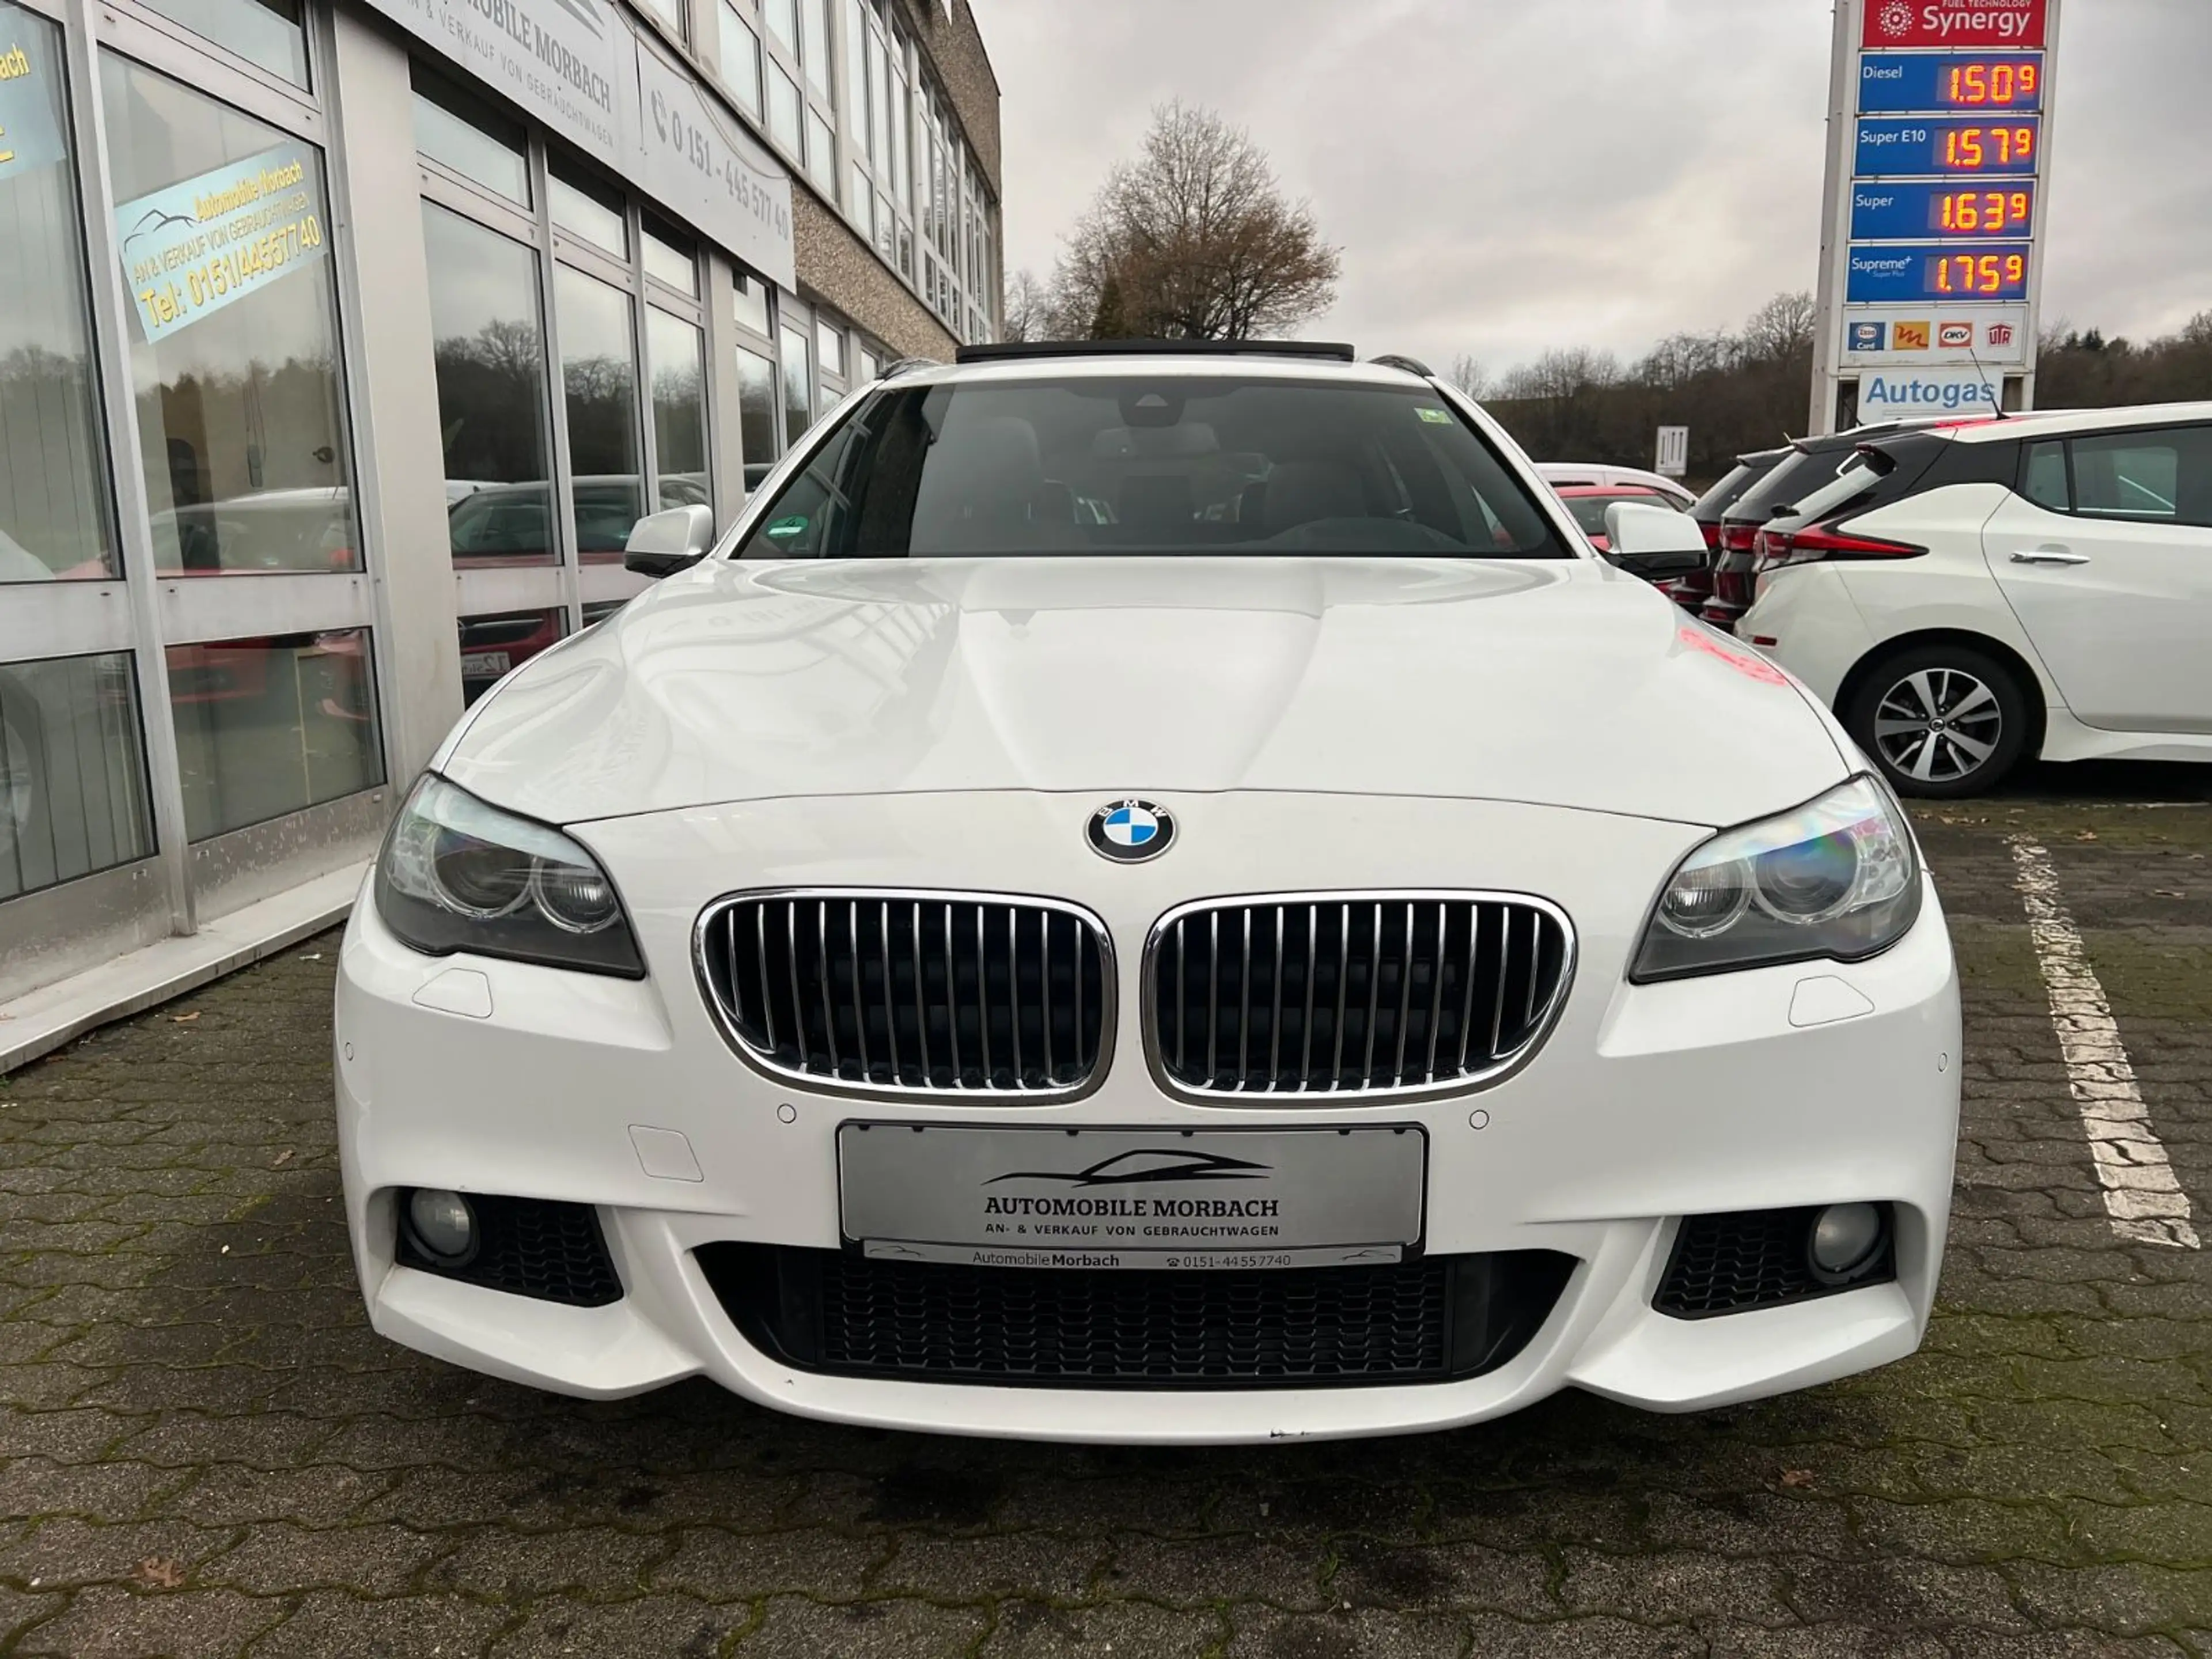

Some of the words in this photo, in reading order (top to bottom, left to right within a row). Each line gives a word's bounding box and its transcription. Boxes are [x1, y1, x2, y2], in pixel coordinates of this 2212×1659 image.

[1922, 6, 2031, 37] Synergy
[439, 8, 494, 61] VERKAUF
[500, 51, 522, 83] VON
[535, 24, 611, 113] MORBACH
[1863, 66, 1903, 79] Diesel
[1860, 130, 1899, 146] Super
[1902, 130, 1926, 143] E10
[726, 160, 749, 209] 445
[752, 182, 771, 228] 577
[1855, 195, 1894, 210] Super
[158, 235, 206, 271] VERKAUF
[205, 225, 230, 251] VON
[1944, 331, 1968, 339] DKV
[1988, 324, 2013, 345] UTA
[1865, 377, 1995, 408] Autogas
[1097, 799, 1168, 817] BMW
[984, 1197, 1147, 1217] AUTOMOBILE
[1153, 1199, 1279, 1217] MORBACH
[985, 1223, 1010, 1233] AN-
[1017, 1225, 1027, 1234] &
[1035, 1225, 1099, 1236] VERKAUF
[1105, 1225, 1136, 1236] VON
[1143, 1225, 1279, 1236] GEBRAUCHTWAGEN
